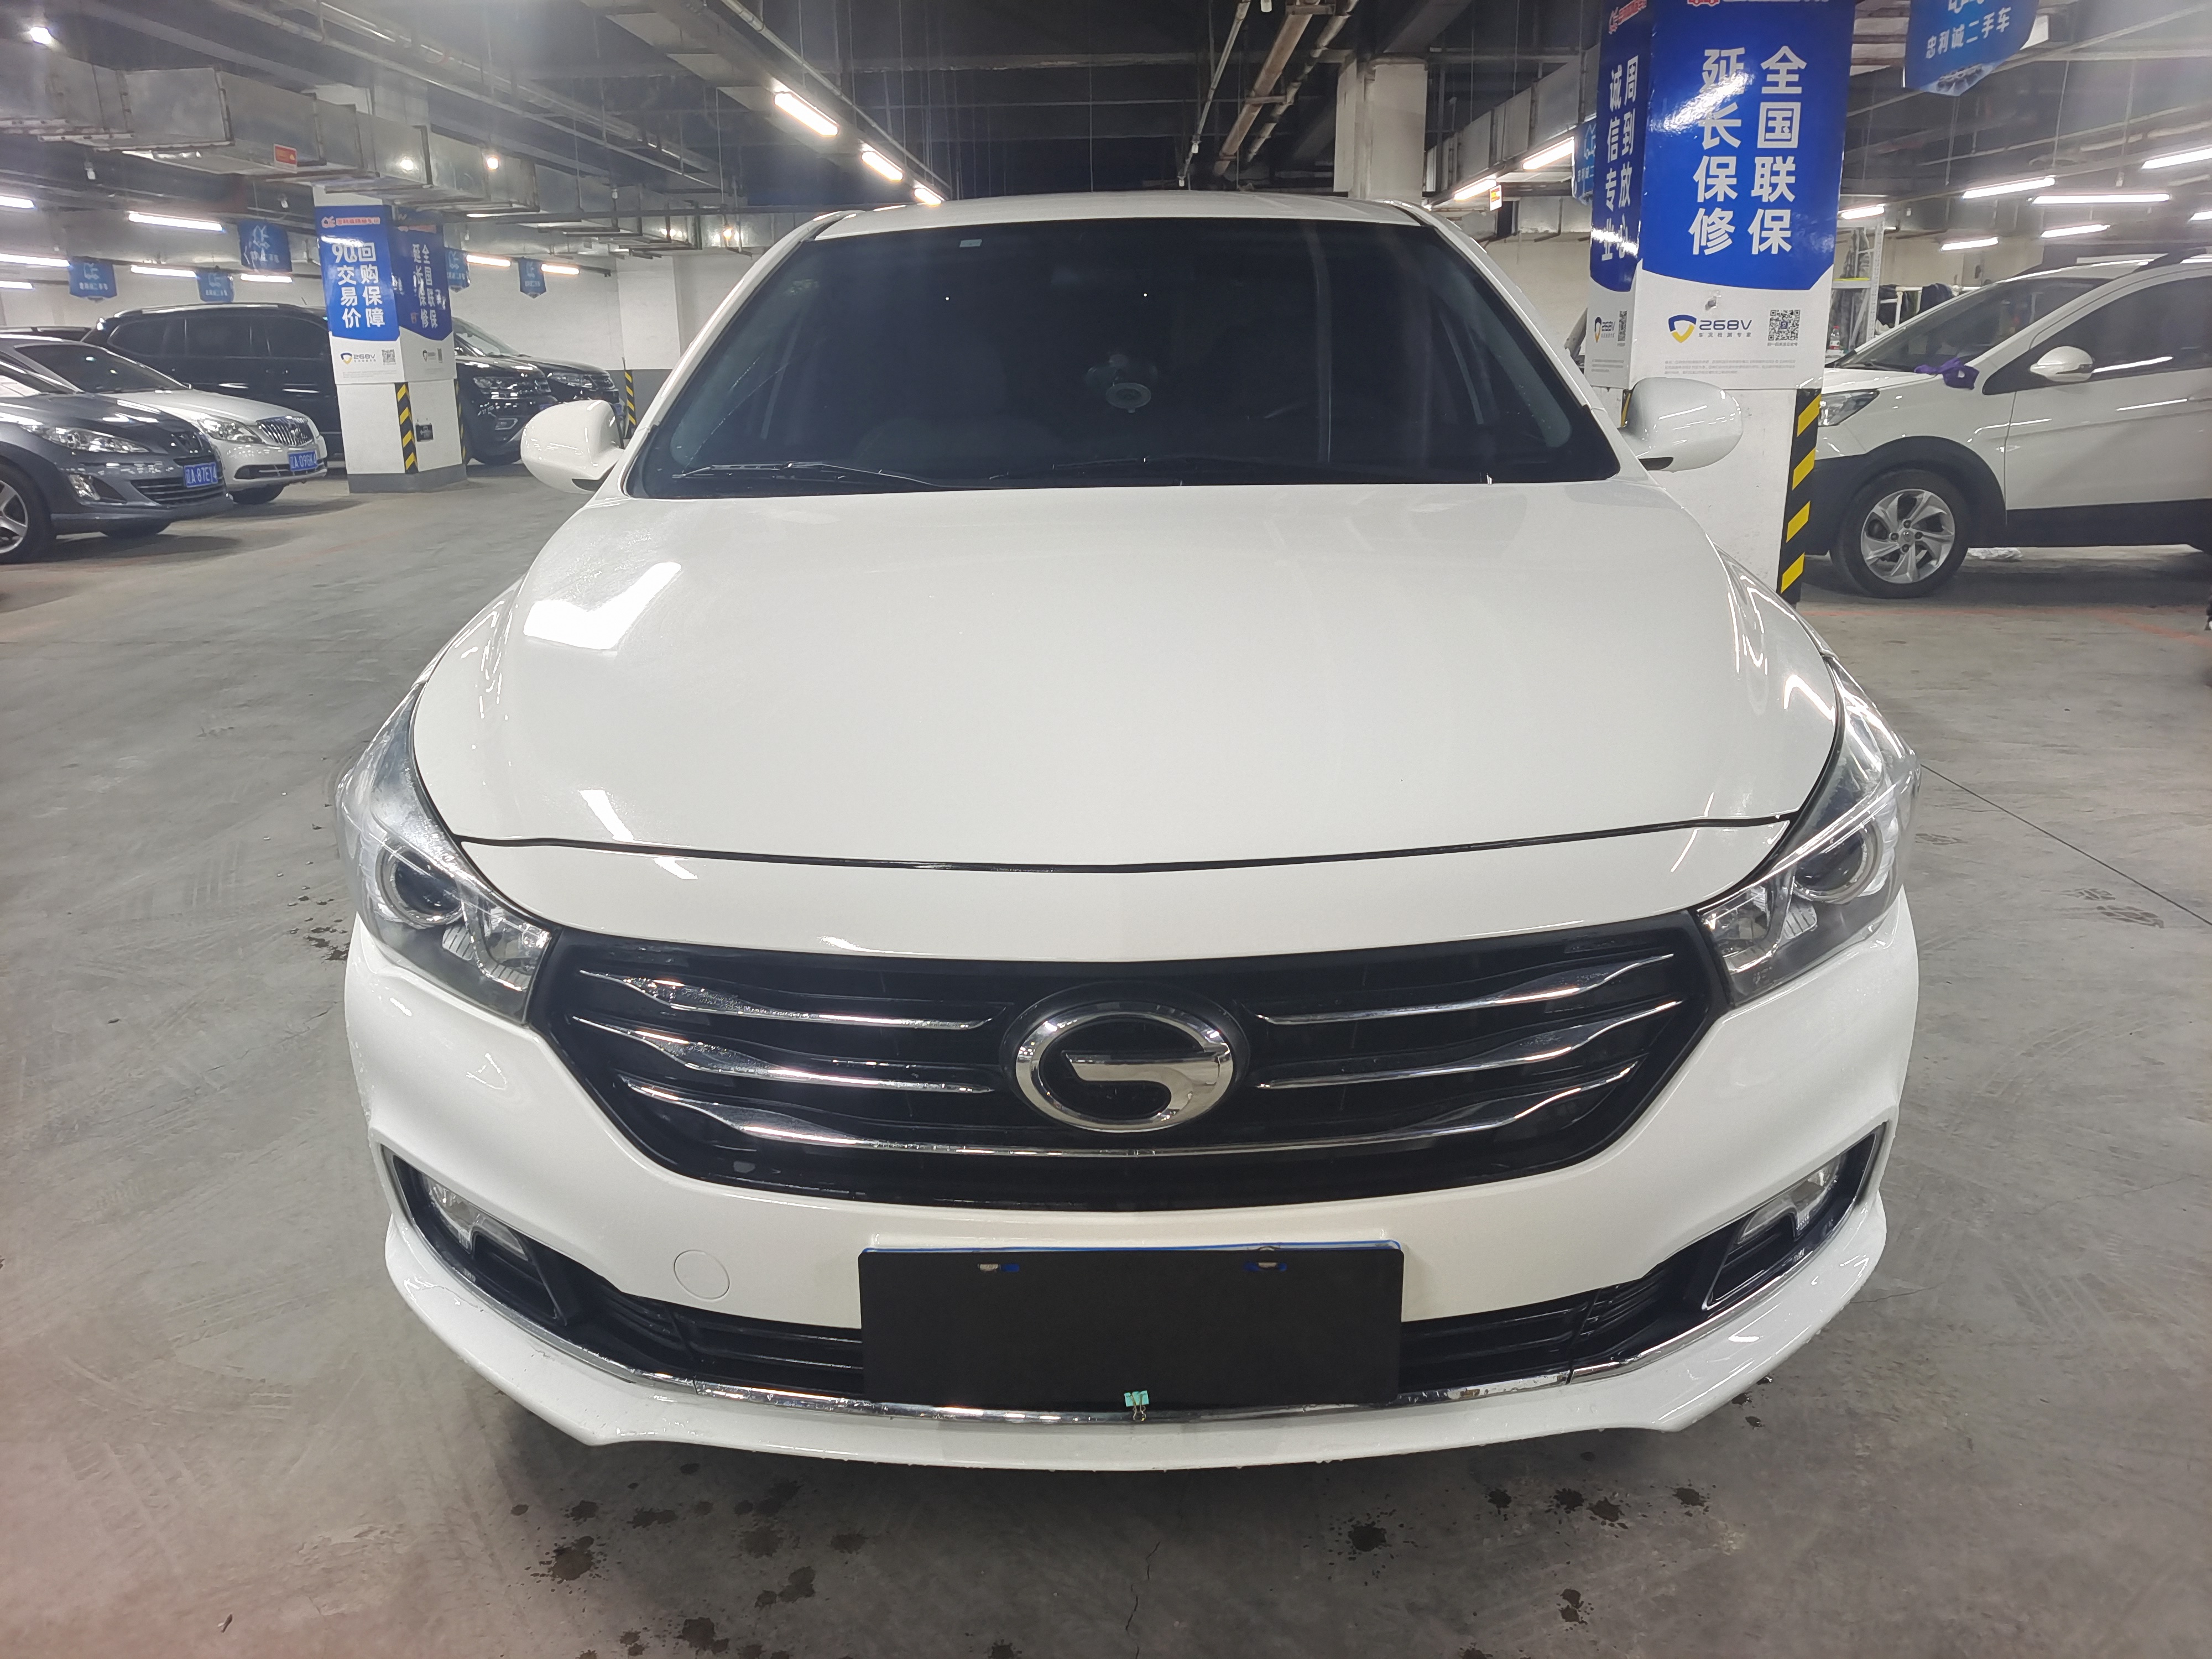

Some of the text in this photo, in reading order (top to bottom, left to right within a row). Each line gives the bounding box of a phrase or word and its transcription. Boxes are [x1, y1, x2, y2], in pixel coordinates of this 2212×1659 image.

[1926, 6, 2012, 59] 忠利诚二手车
[1688, 47, 1745, 255] 延长保修
[1747, 45, 1807, 255] 全国联保
[358, 242, 385, 327] 回购保障
[1699, 319, 1752, 331] 268V
